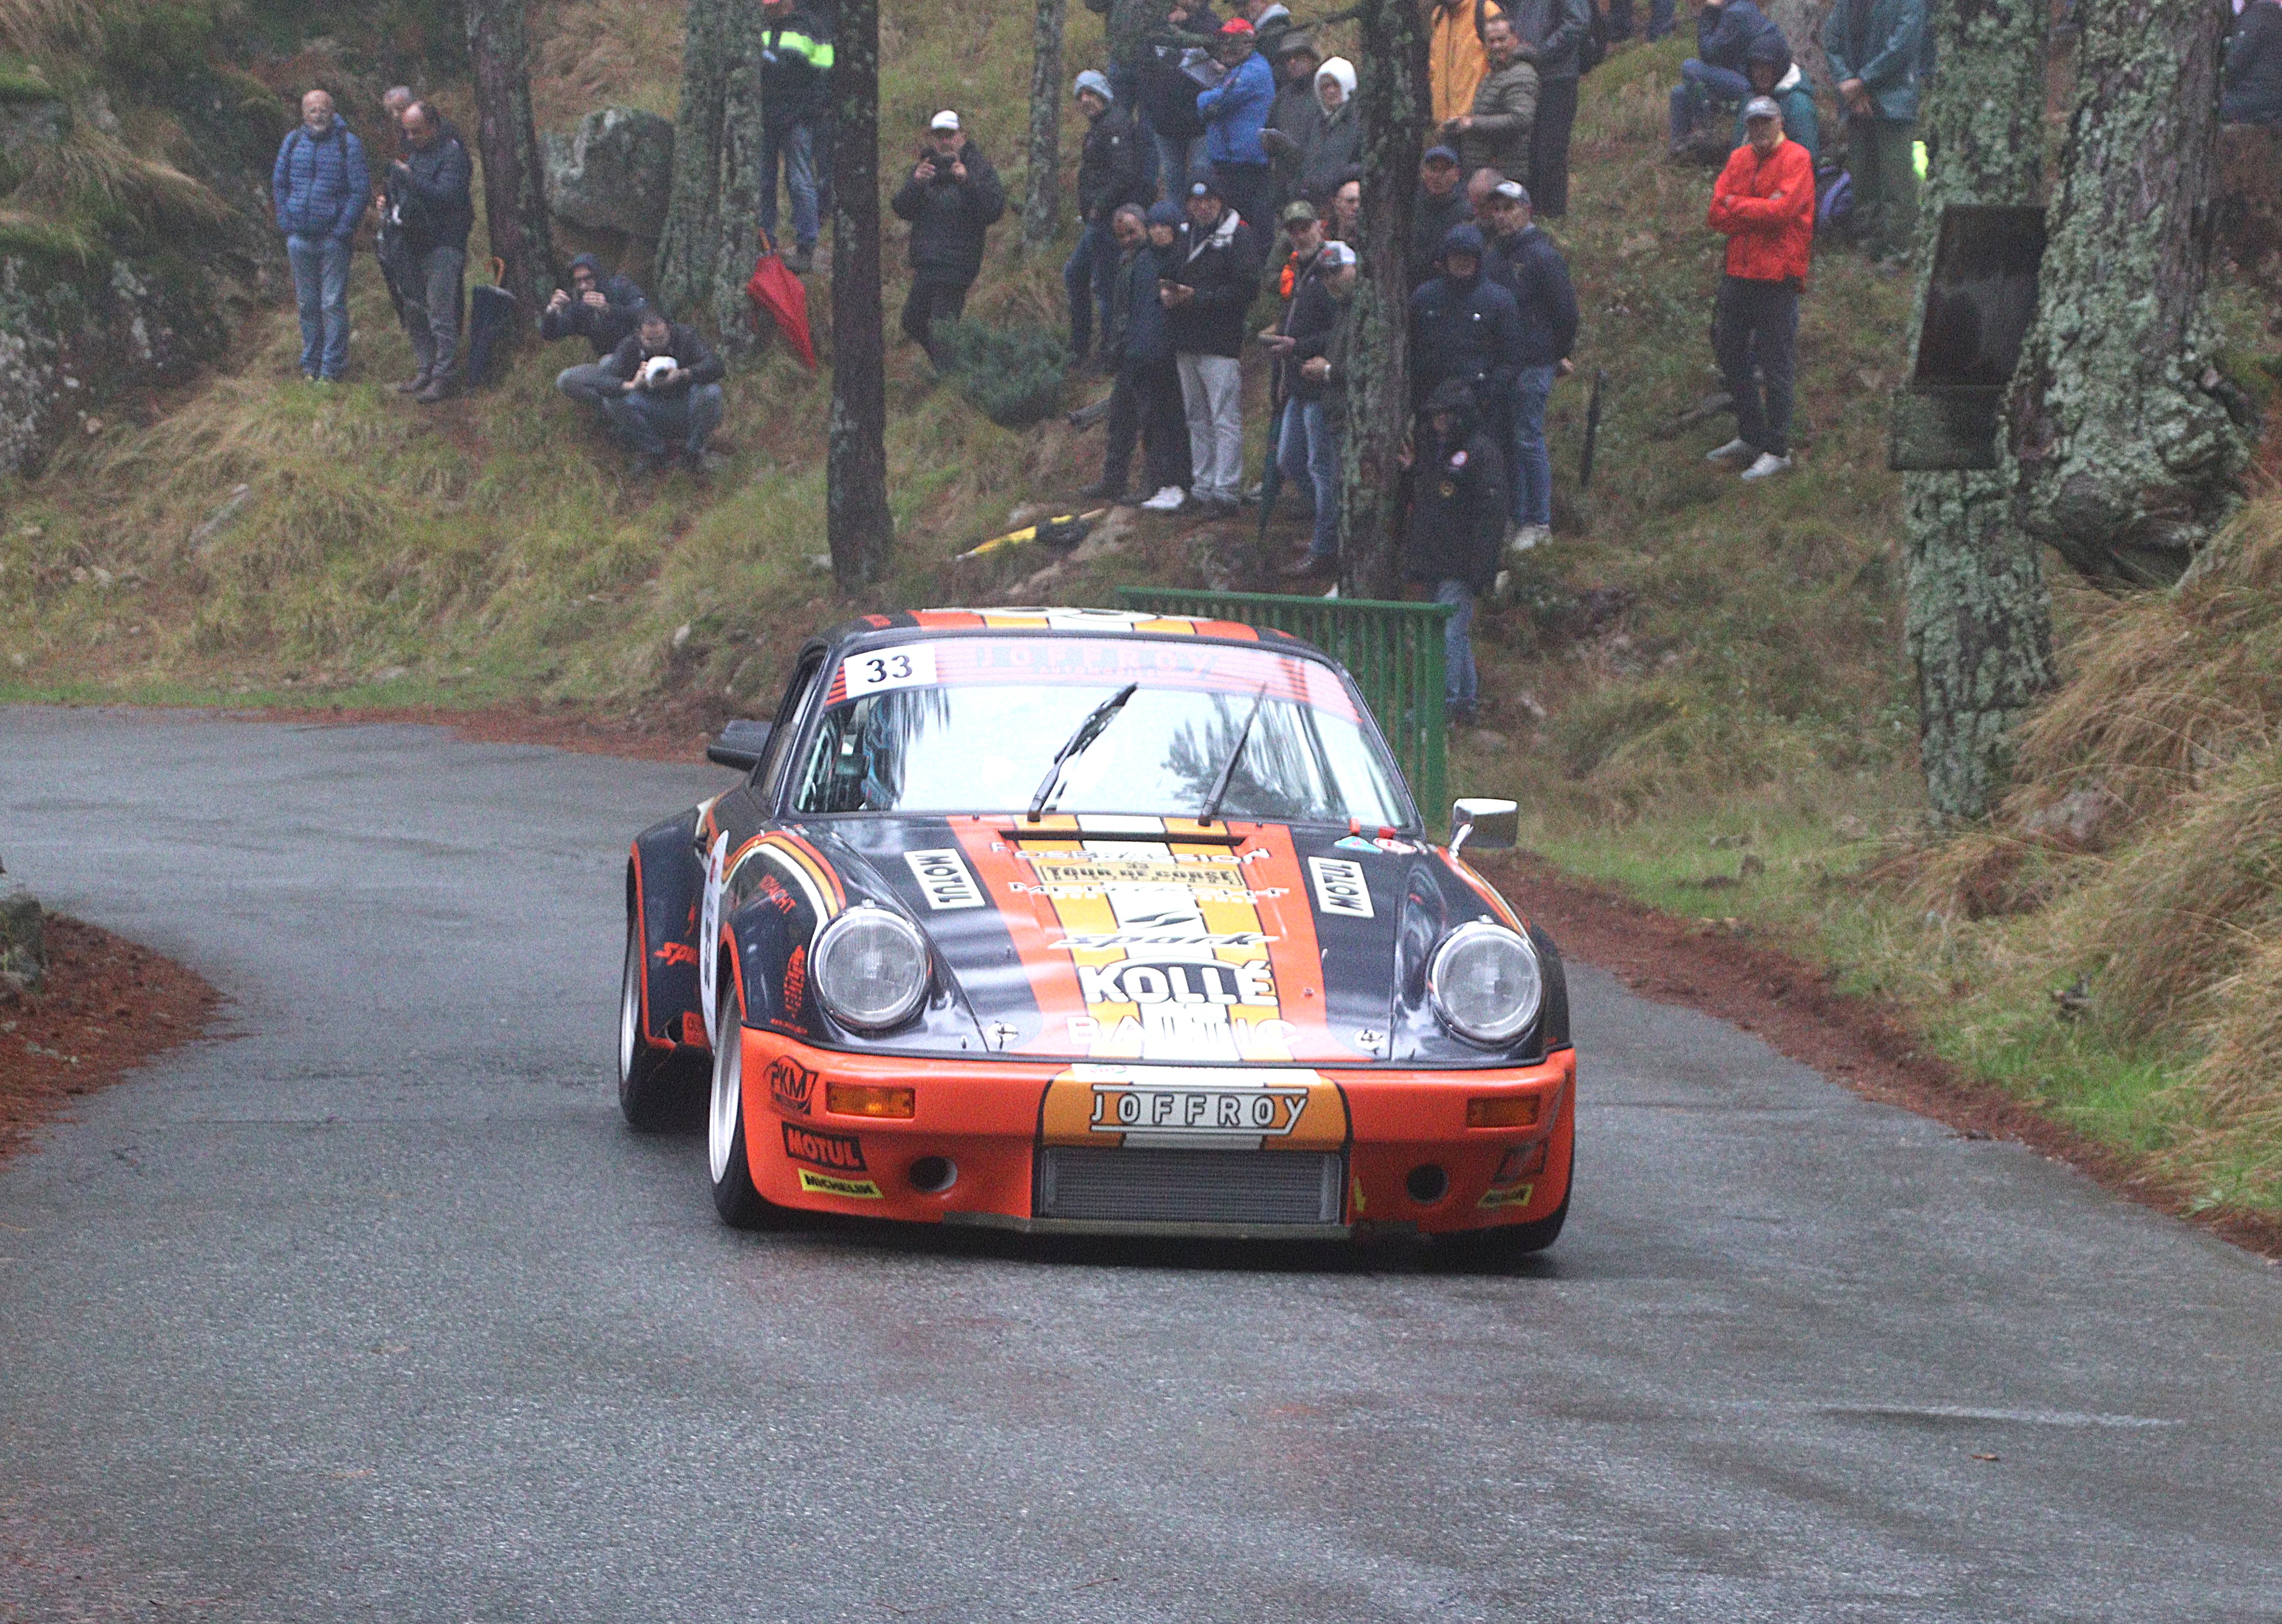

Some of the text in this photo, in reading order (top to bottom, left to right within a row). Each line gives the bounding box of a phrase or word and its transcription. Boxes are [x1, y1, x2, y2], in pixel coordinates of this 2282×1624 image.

[866, 654, 913, 683] 33
[981, 646, 1211, 677] JOFFROY
[914, 854, 973, 903] MOTUL
[1319, 862, 1364, 911] MOTUL
[1079, 961, 1278, 1006] KOLLÉ
[1089, 1091, 1308, 1130] JOFFROY
[787, 1128, 861, 1167] MOTUL
